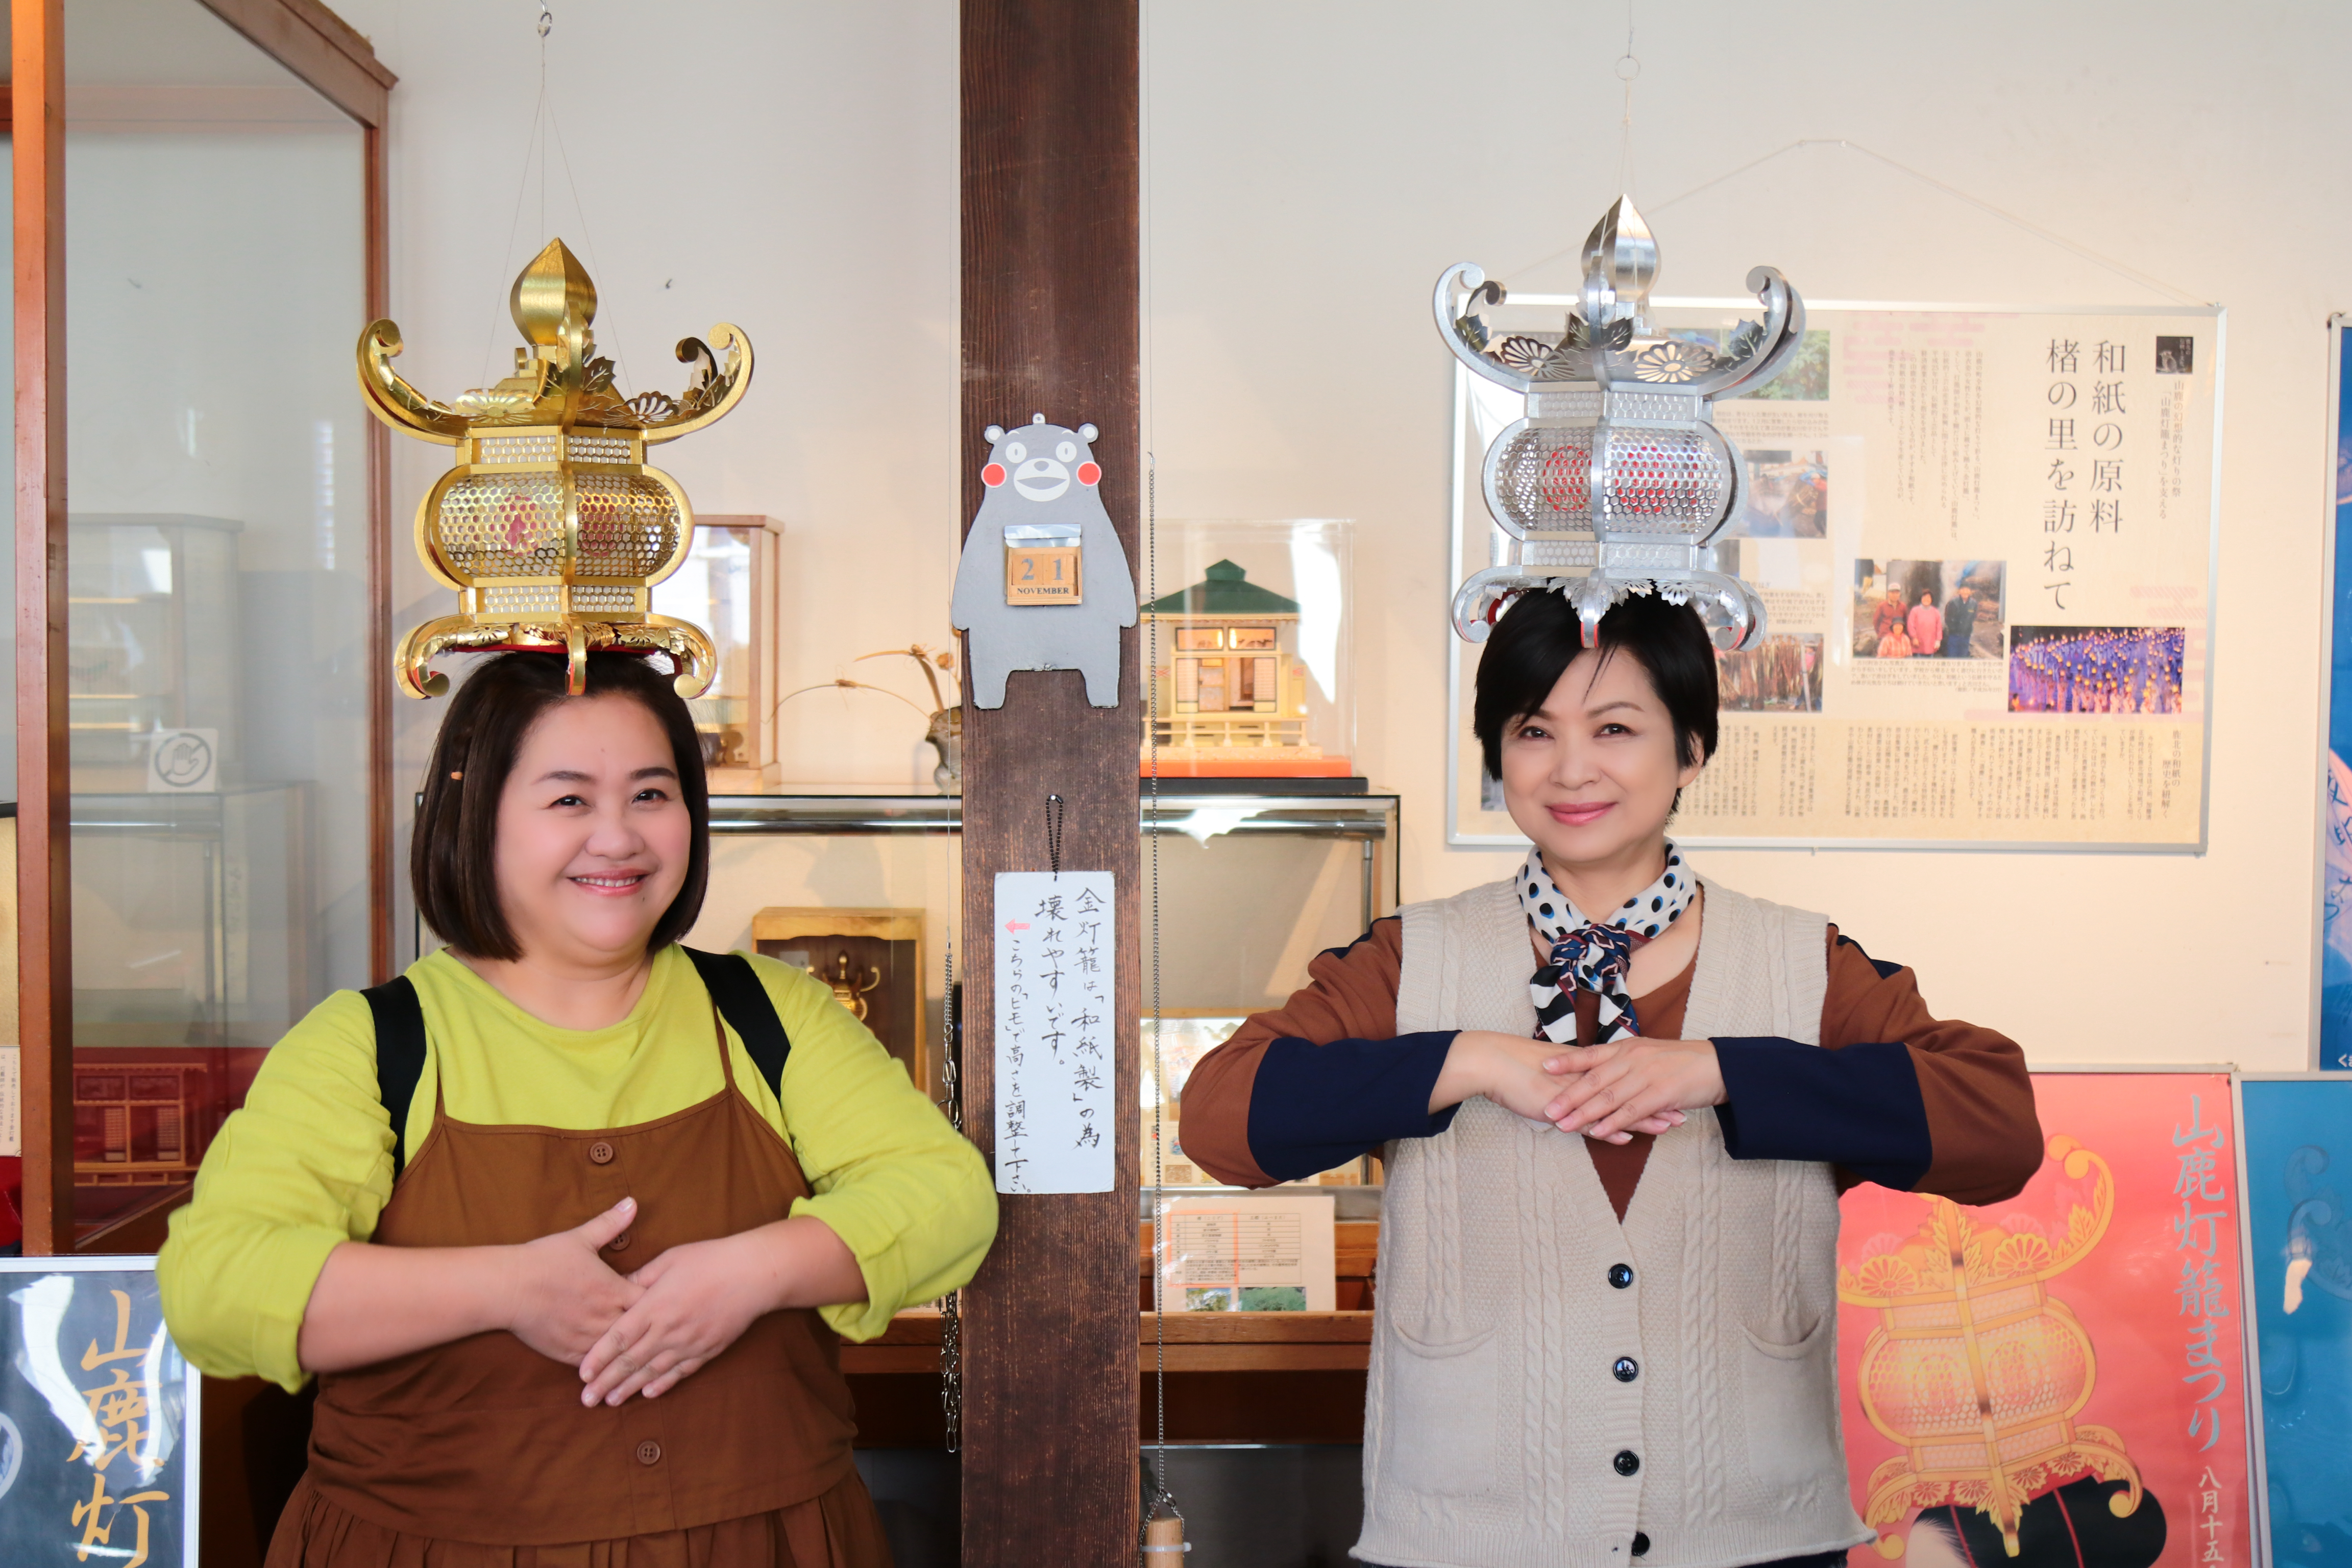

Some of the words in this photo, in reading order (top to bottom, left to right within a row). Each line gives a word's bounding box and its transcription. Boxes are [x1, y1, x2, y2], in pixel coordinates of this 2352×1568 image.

[2044, 339, 2080, 610] 楮の里を訪ねて
[2090, 339, 2126, 534] 和紙の原料
[1021, 558, 1064, 581] 21
[1004, 939, 1032, 1193] こちらの「ヒモ」で高さを調整して下さい。
[1035, 895, 1068, 1065] 壊れやすいです。
[2172, 1094, 2230, 1453] 山鹿灯籠まつり
[66, 1289, 170, 1568] 山鹿灯
[2198, 1465, 2224, 1568] 八月十五
